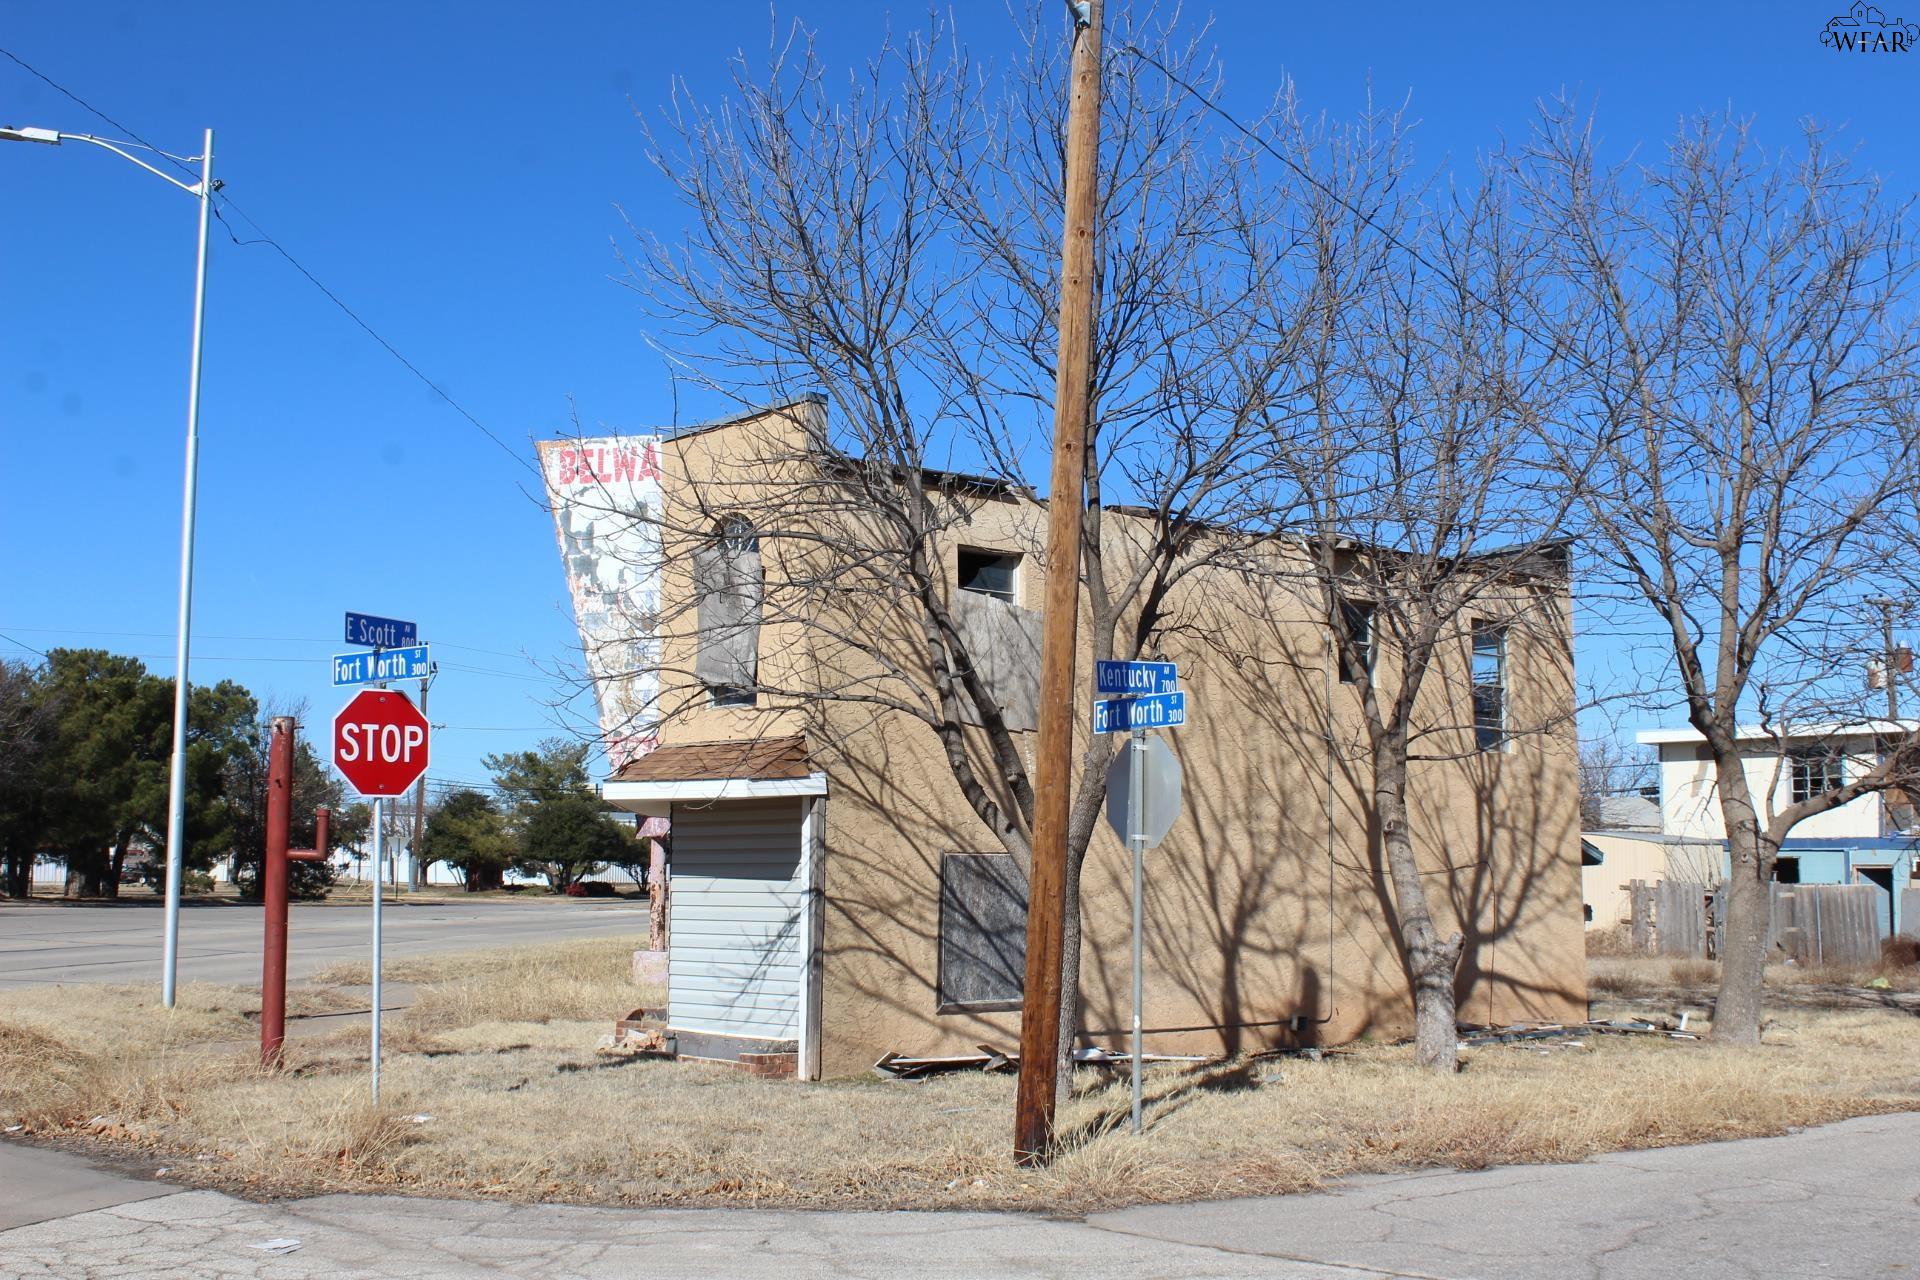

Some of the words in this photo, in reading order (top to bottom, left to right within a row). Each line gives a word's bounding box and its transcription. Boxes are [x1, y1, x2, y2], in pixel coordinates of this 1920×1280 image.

[347, 616, 354, 640] E
[359, 618, 396, 646] Scott
[401, 637, 415, 648] 800
[335, 657, 361, 682] Fort
[367, 653, 406, 679] Worth
[414, 649, 422, 659] ST
[411, 662, 427, 676] 300
[1099, 662, 1156, 694] Kentucky
[1161, 680, 1175, 692] 700
[1096, 704, 1120, 729] Fort
[1126, 699, 1163, 725] Worth
[1170, 695, 1177, 705] ST
[1167, 709, 1183, 723] 300
[339, 722, 424, 763] STOP
